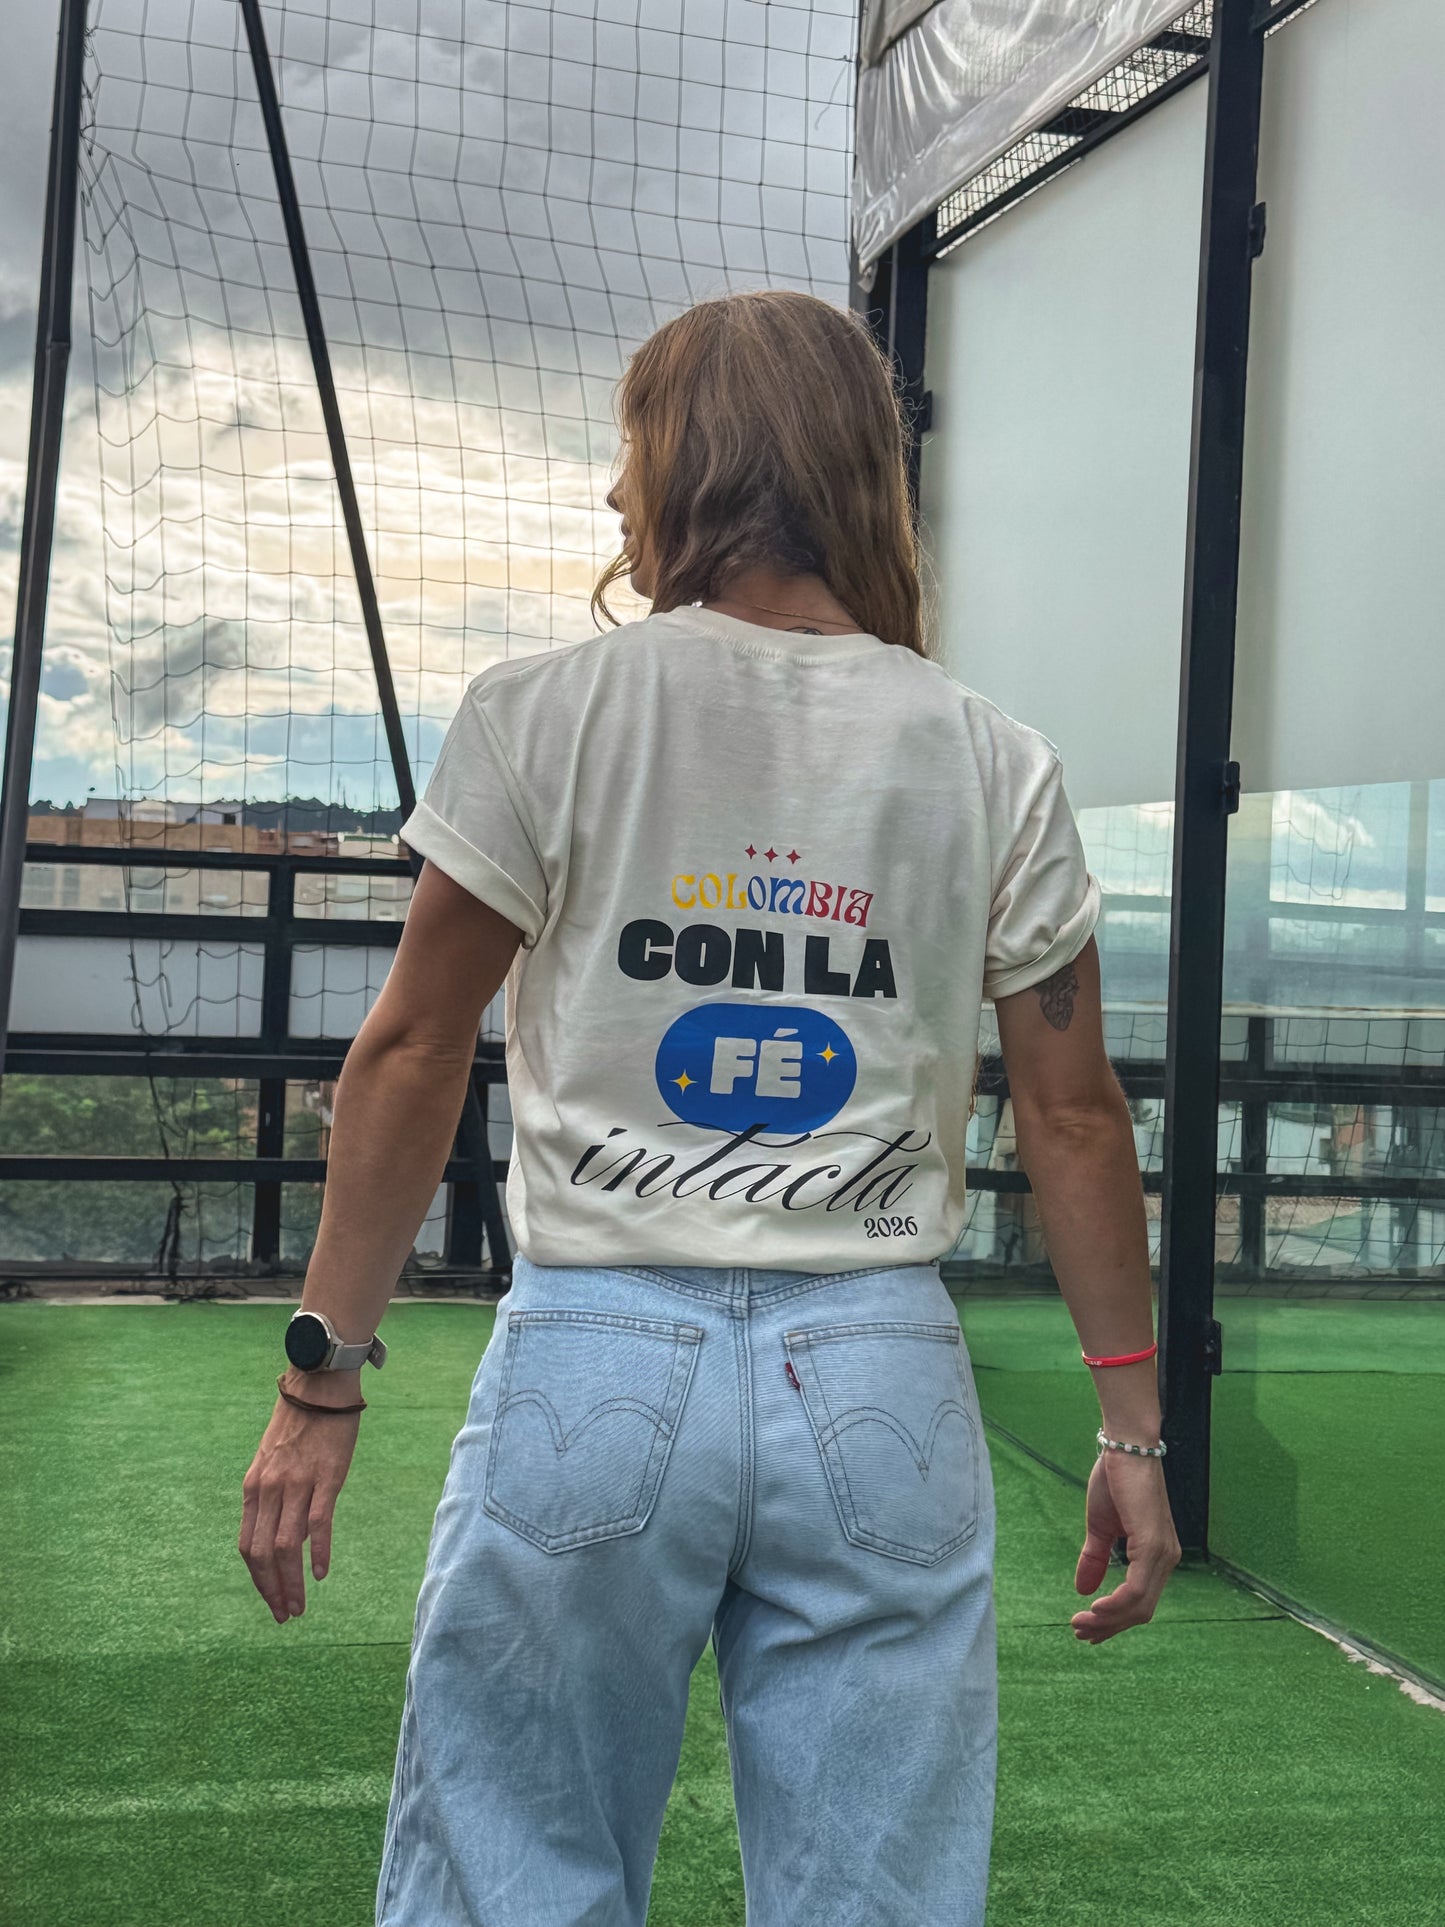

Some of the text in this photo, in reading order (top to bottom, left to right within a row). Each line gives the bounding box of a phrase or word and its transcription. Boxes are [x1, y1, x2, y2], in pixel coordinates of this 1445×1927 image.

[672, 873, 874, 927] COLOMBIA
[617, 918, 898, 998] CON LA
[710, 1027, 803, 1099] FÉ
[571, 1121, 931, 1212] intacta
[864, 1216, 918, 1239] 2026
